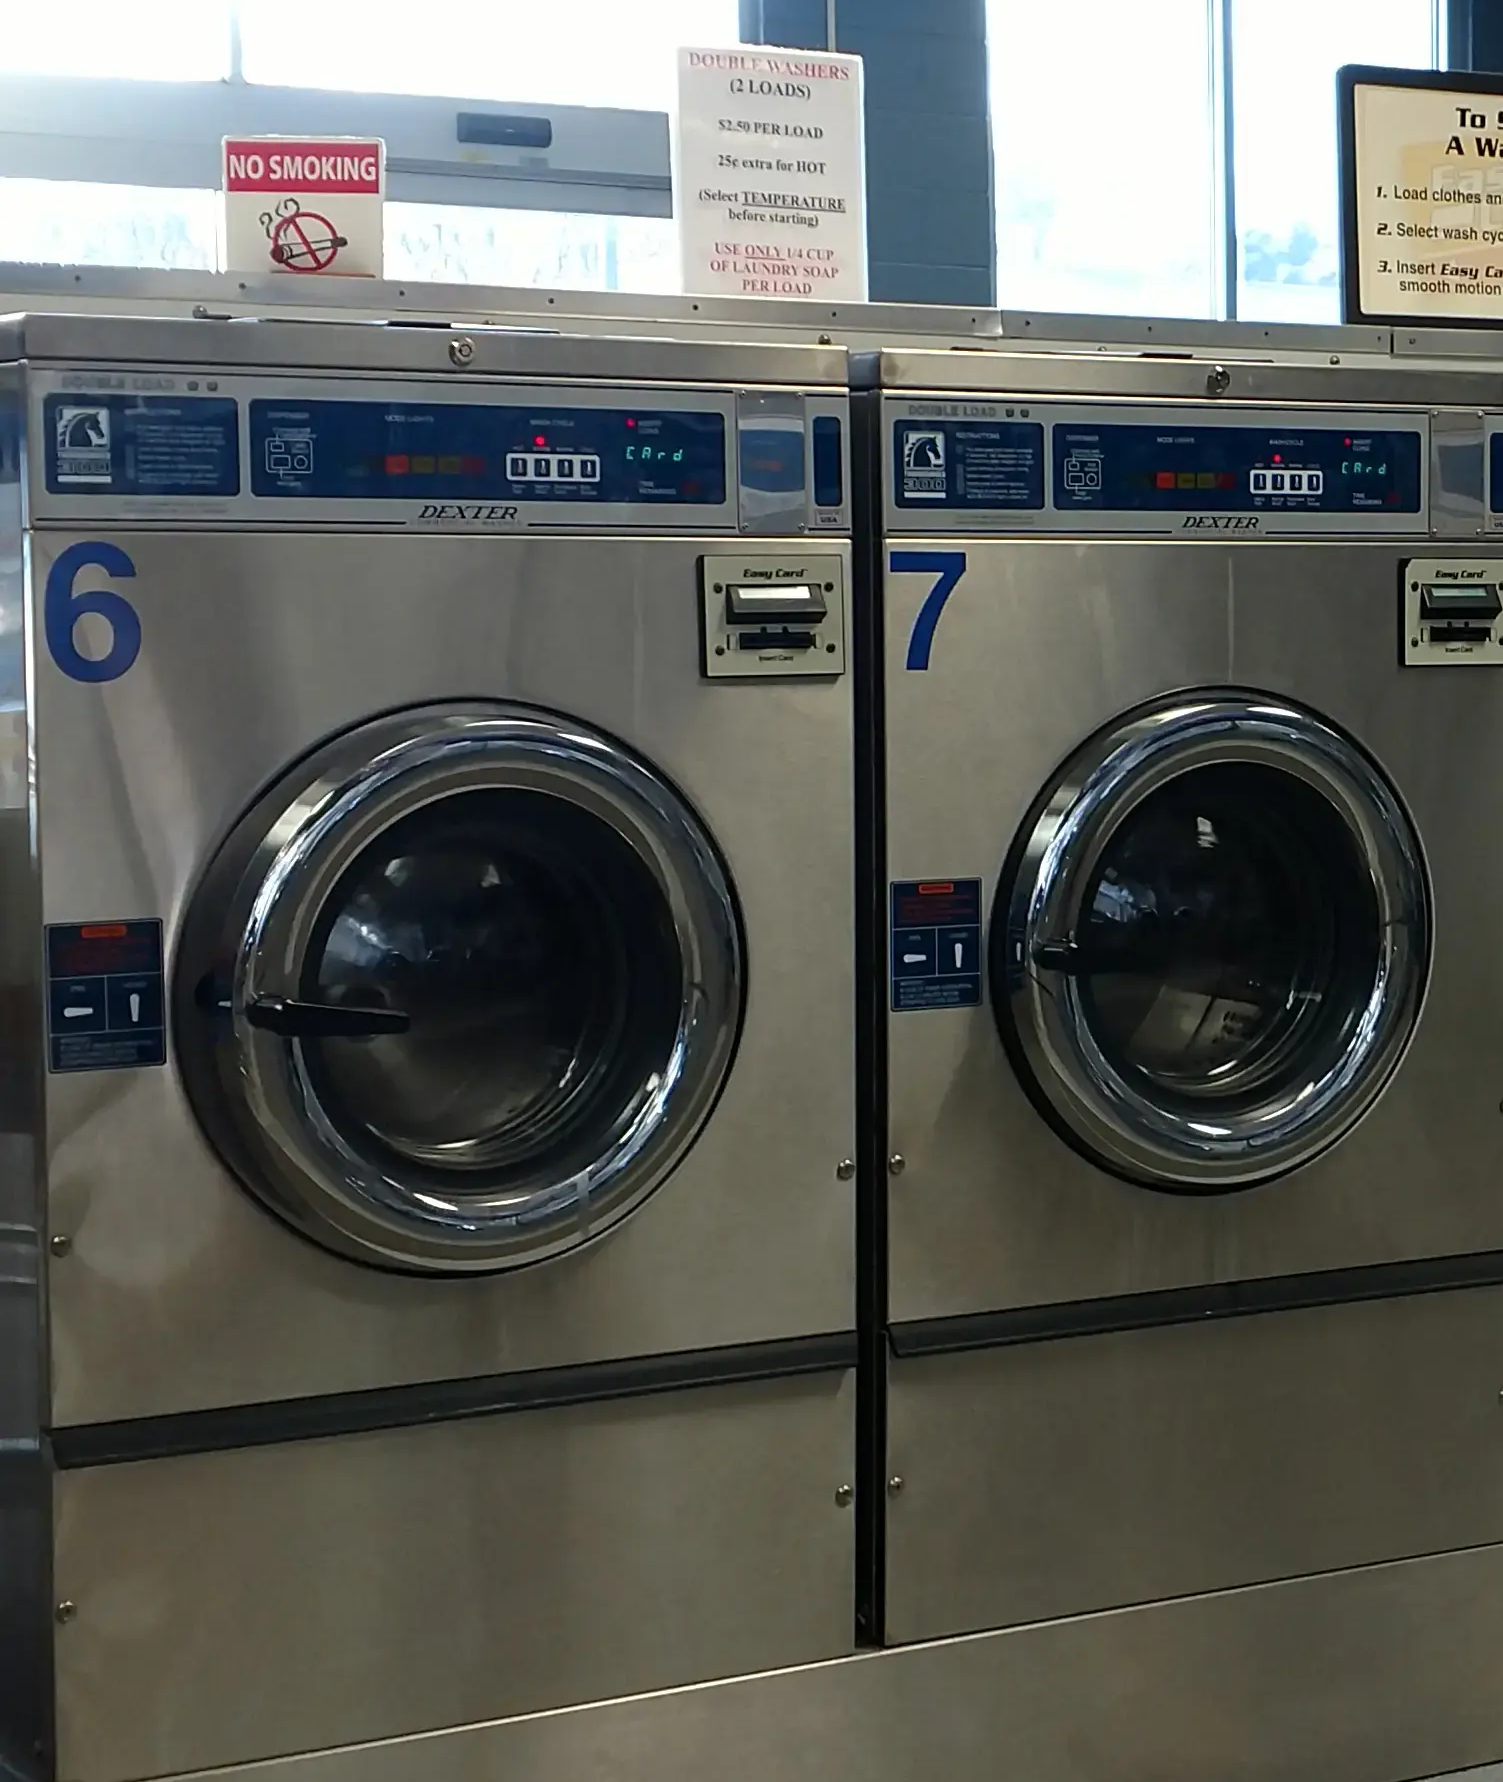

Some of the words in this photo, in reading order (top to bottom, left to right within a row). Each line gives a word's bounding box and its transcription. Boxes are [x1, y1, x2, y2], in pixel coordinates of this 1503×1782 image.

[689, 52, 762, 72] DOUBLE
[767, 60, 850, 80] WASHERS
[730, 78, 743, 94] (2
[750, 80, 811, 100] LOADS)
[1456, 107, 1486, 129] To
[754, 123, 781, 135] PER
[785, 126, 823, 140] LOAD
[1445, 136, 1464, 156] A
[228, 154, 263, 180] NO
[268, 154, 377, 181] SMOKING
[742, 159, 772, 171] extra
[776, 159, 793, 172] for
[797, 161, 827, 175] HOT
[699, 189, 738, 204] (Select
[742, 191, 845, 211] TEMPERATURE
[1376, 186, 1388, 199] 1.
[1394, 185, 1428, 201] Load
[1432, 187, 1481, 205] clothes
[728, 209, 766, 223] before
[769, 211, 819, 228] starting)
[1376, 223, 1392, 236] 2.
[1396, 222, 1439, 239] Select
[1442, 225, 1478, 241] wash
[715, 242, 741, 256] USE
[744, 244, 785, 259] ONLY
[807, 248, 834, 261] CUP
[710, 261, 729, 273] OF
[733, 262, 798, 277] LAUNDRY
[803, 265, 839, 279] SOAP
[1377, 260, 1392, 274] 3.
[1396, 260, 1436, 276] Insert
[1440, 262, 1479, 280] Easy
[742, 279, 769, 292] PER
[773, 280, 812, 295] LOAD
[1399, 278, 1450, 294] smooth
[1455, 280, 1501, 296] motion
[908, 404, 959, 417] DOUBLE
[964, 406, 996, 417] LOAD
[419, 505, 518, 519] DEXTER
[1182, 517, 1259, 528] DEXTER
[743, 569, 772, 580] Easy
[776, 569, 805, 578] Card
[1435, 570, 1459, 580] Easy
[1461, 570, 1484, 578] Card
[44, 541, 142, 683] 6
[890, 551, 966, 670] 7
